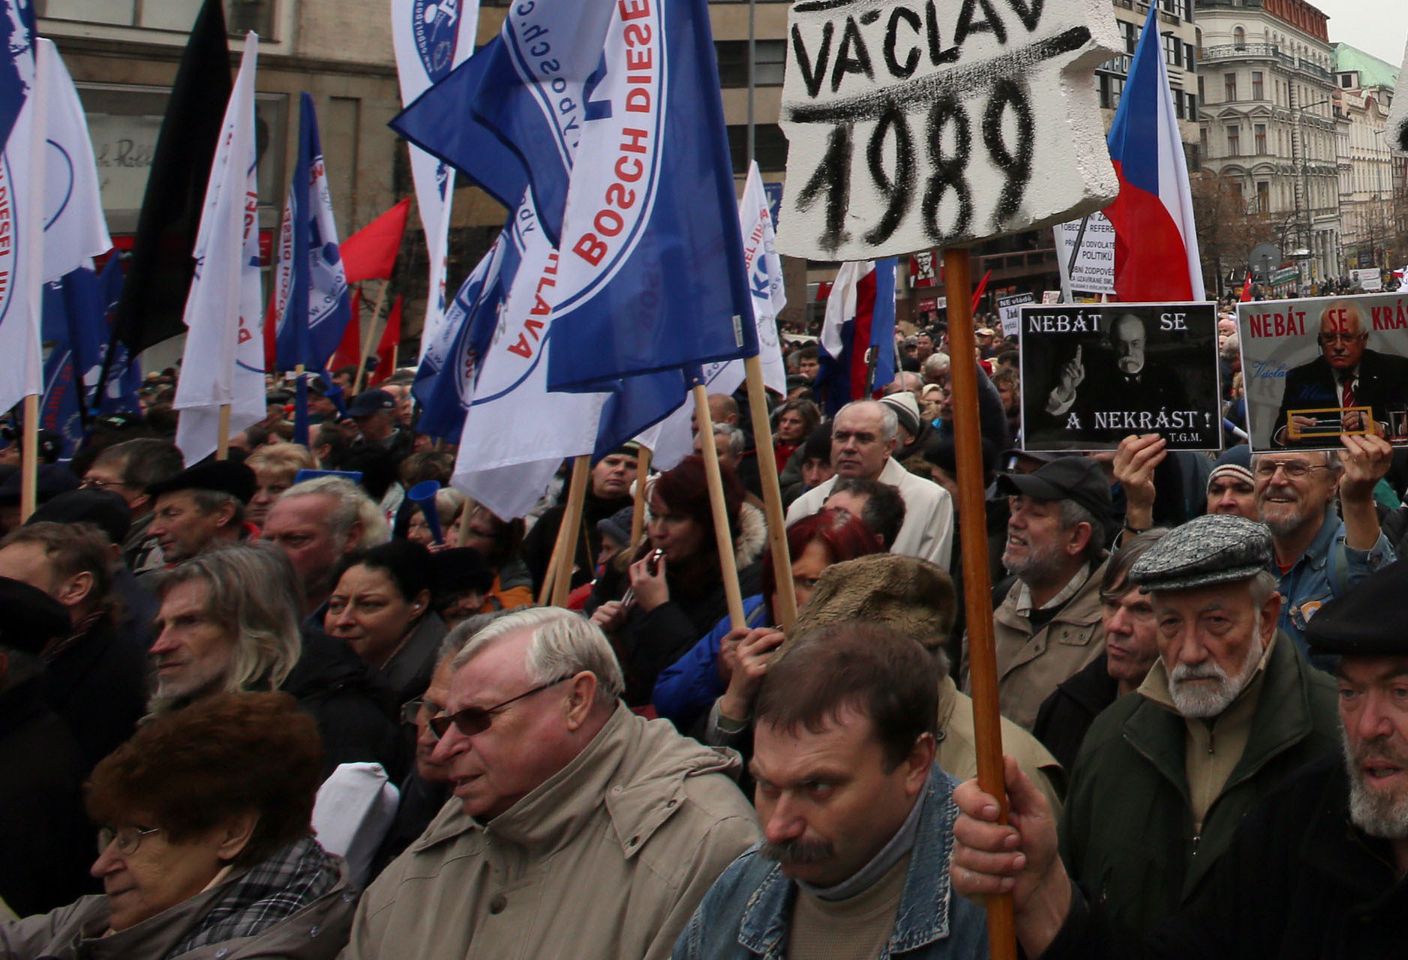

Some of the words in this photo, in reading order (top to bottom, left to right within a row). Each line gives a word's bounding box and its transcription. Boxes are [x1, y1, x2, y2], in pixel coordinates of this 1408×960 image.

[795, 76, 1037, 254] 1989
[1029, 310, 1103, 333] NEBÁT
[1160, 312, 1187, 331] SE
[1249, 306, 1307, 338] NEBÁT
[1328, 309, 1348, 332] SE
[1066, 412, 1082, 429] A
[1095, 407, 1198, 429] NEKRÁST
